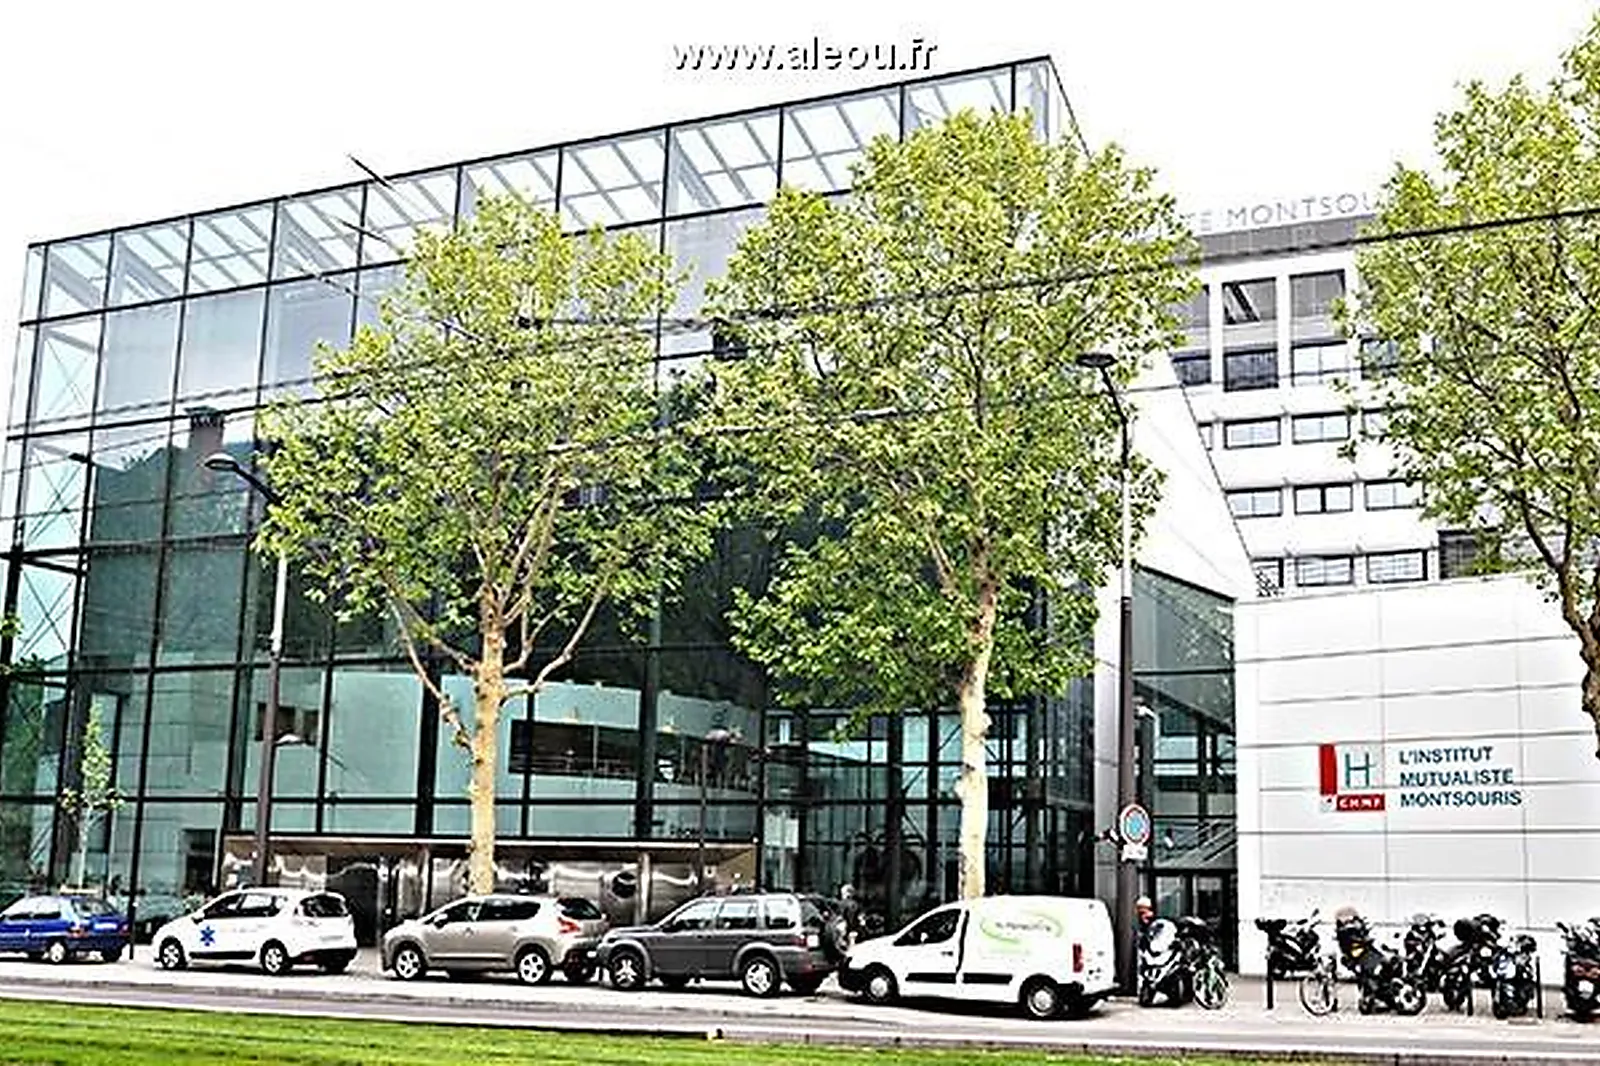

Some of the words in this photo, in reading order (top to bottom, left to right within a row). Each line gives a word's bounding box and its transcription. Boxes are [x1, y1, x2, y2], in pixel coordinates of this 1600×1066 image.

[1399, 746, 1493, 765] L'INSTITUT
[1400, 768, 1514, 787] MUTUALISTE
[1400, 790, 1522, 808] MONTSOURIS
